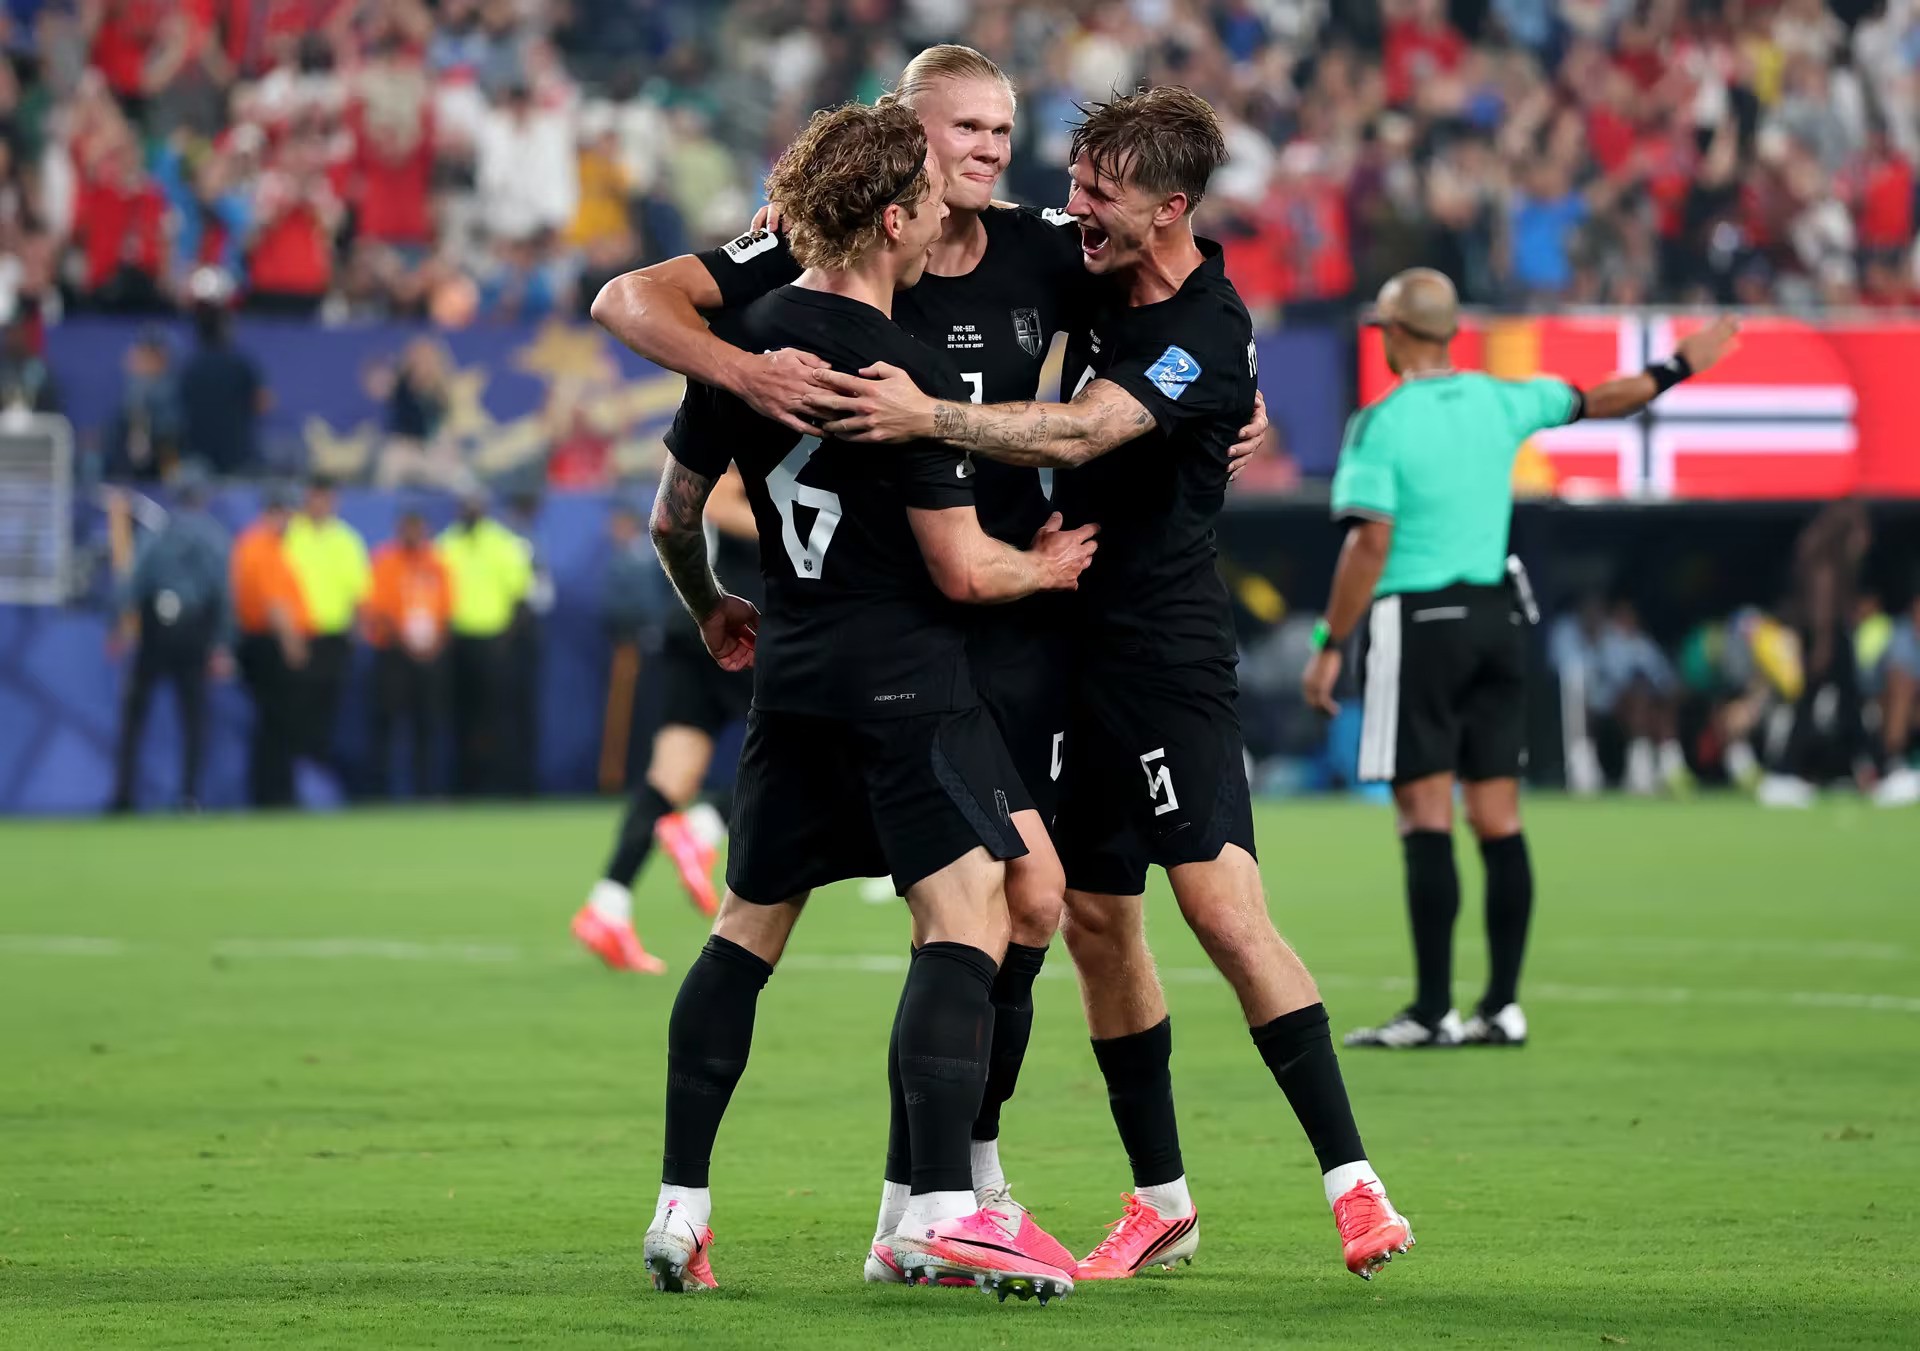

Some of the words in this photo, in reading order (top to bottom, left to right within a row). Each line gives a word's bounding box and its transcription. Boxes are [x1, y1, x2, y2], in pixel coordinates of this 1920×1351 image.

[765, 433, 843, 580] 6
[874, 693, 916, 701] AERO-FIT
[1139, 747, 1179, 816] 5
